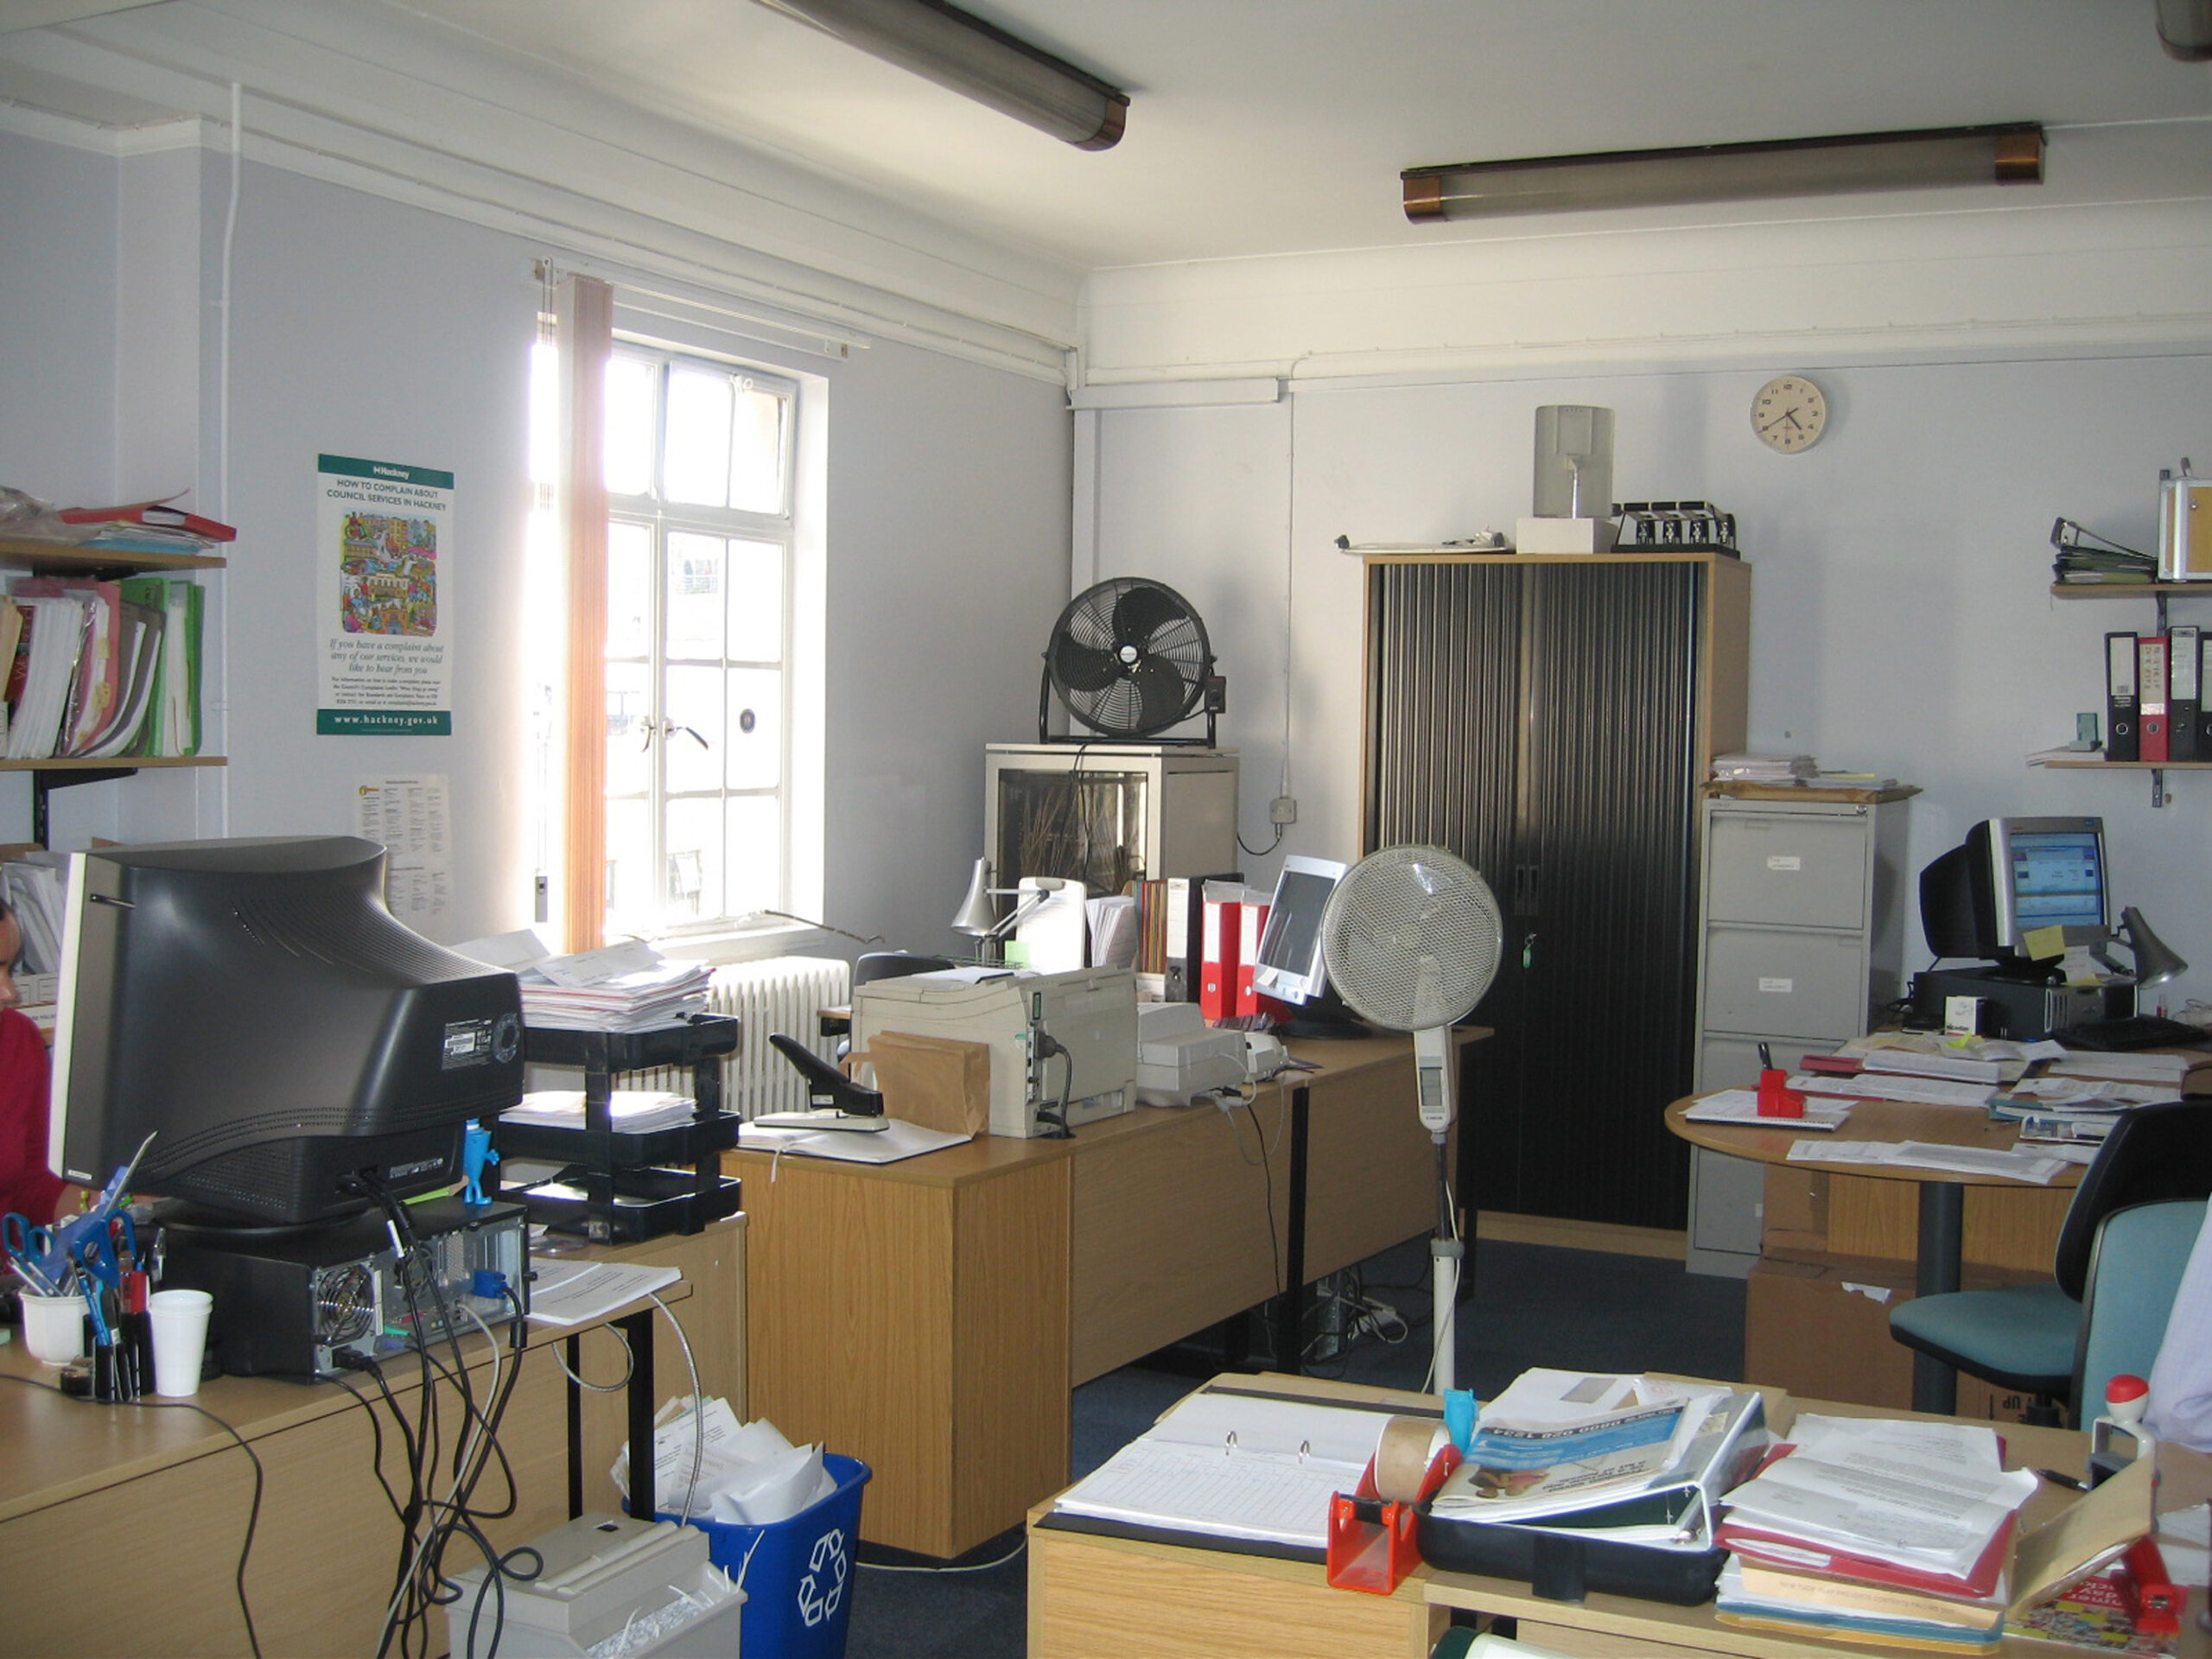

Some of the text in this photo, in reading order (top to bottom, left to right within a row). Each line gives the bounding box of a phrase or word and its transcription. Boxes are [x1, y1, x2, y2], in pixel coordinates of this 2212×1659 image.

[337, 479, 438, 499] HOW TO COMPLAIN ABOUT
[327, 489, 446, 512] COUNCIL SERVICES IN HACKNEY
[338, 640, 353, 650] you
[356, 639, 376, 650] have
[384, 642, 422, 653] complaint
[423, 642, 444, 652] about
[331, 652, 346, 662] any
[349, 651, 359, 663] of
[420, 654, 443, 664] would
[348, 663, 364, 672] like
[365, 664, 375, 672] to
[393, 664, 413, 677] from
[413, 667, 429, 677] you
[334, 715, 438, 726] www.hackney.gov.uk
[2003, 1395, 2020, 1409] UP
